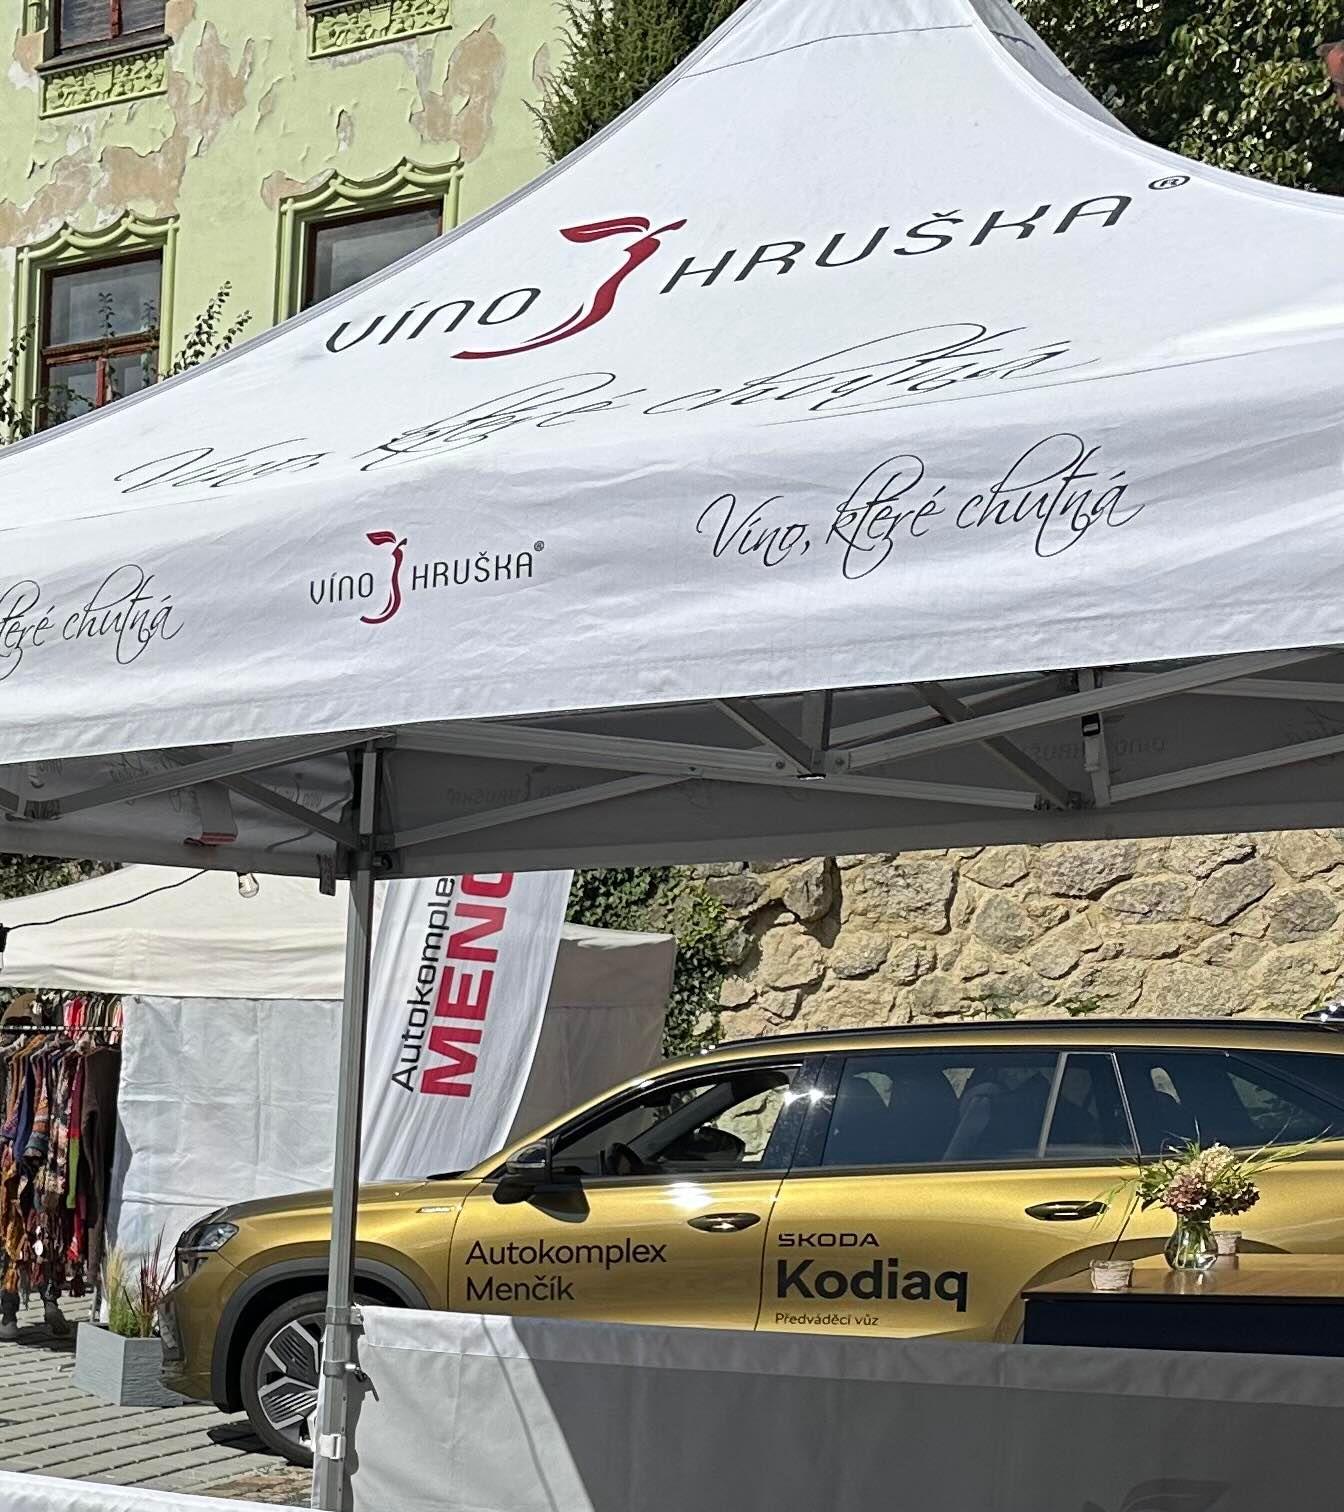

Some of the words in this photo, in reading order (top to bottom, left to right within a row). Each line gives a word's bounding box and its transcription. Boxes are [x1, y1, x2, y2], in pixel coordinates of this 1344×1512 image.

[696, 493, 810, 567] Víno,
[825, 453, 947, 580] které
[956, 432, 1147, 558] chutná
[62, 563, 185, 665] chutná
[465, 1237, 668, 1270] Autokomplex
[466, 1274, 575, 1302] Menčík
[775, 1257, 969, 1313] Kodiaq
[855, 1312, 880, 1327] vůz
